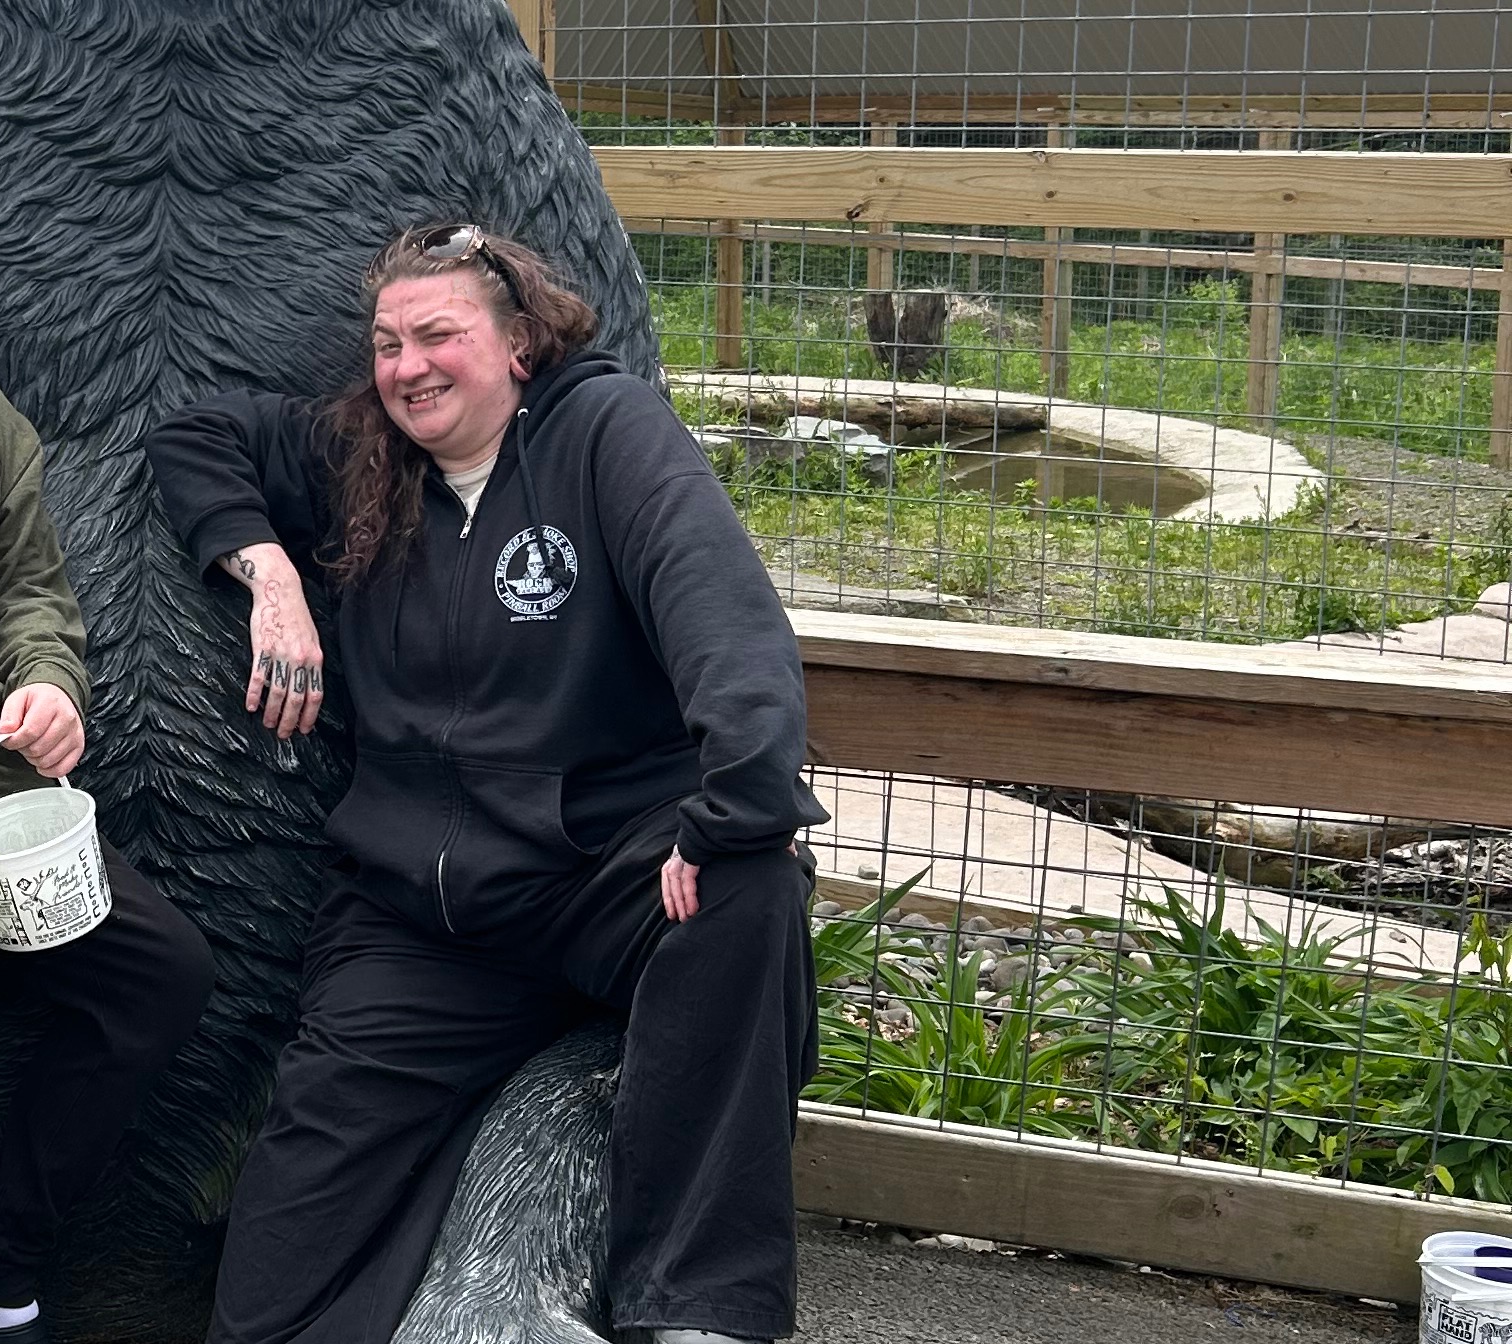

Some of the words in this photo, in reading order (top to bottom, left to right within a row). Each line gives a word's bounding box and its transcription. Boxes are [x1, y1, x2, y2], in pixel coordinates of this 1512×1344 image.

[518, 578, 553, 588] ROCK
[501, 592, 540, 613] PINBALL
[1441, 1313, 1474, 1332] FLAT
[1441, 1321, 1472, 1340] HAND
